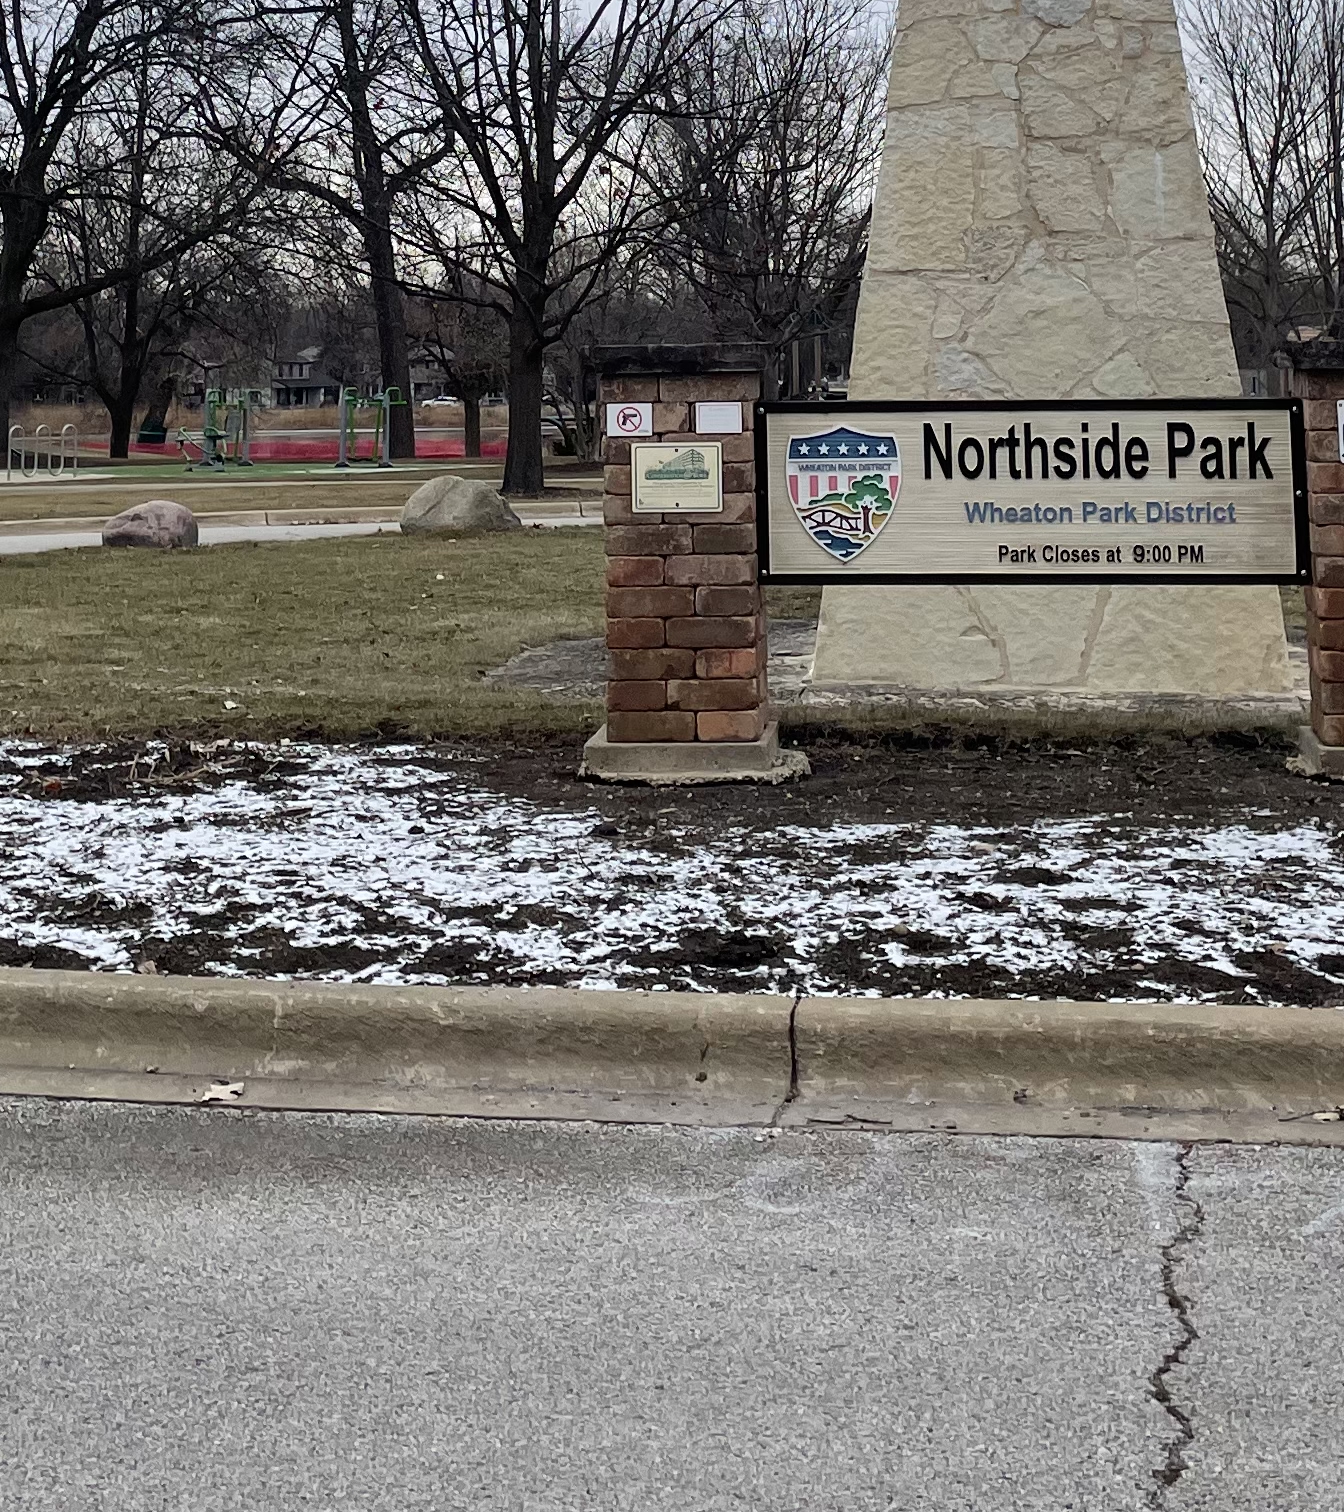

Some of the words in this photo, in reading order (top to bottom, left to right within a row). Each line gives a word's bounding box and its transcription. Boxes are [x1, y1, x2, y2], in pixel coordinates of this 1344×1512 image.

[922, 421, 1150, 481] Northside
[1166, 421, 1275, 481] Park
[797, 463, 836, 472] WHEATON
[838, 463, 858, 472] PARK
[858, 463, 892, 471] DISTRICT
[964, 501, 1073, 524] Wheaton
[1082, 501, 1138, 524] Park
[1146, 501, 1237, 524] District
[998, 544, 1037, 563] Park
[1042, 544, 1100, 563] Closes
[1106, 546, 1122, 563] at
[1133, 544, 1172, 563] 9:00
[1178, 544, 1204, 563] PM
